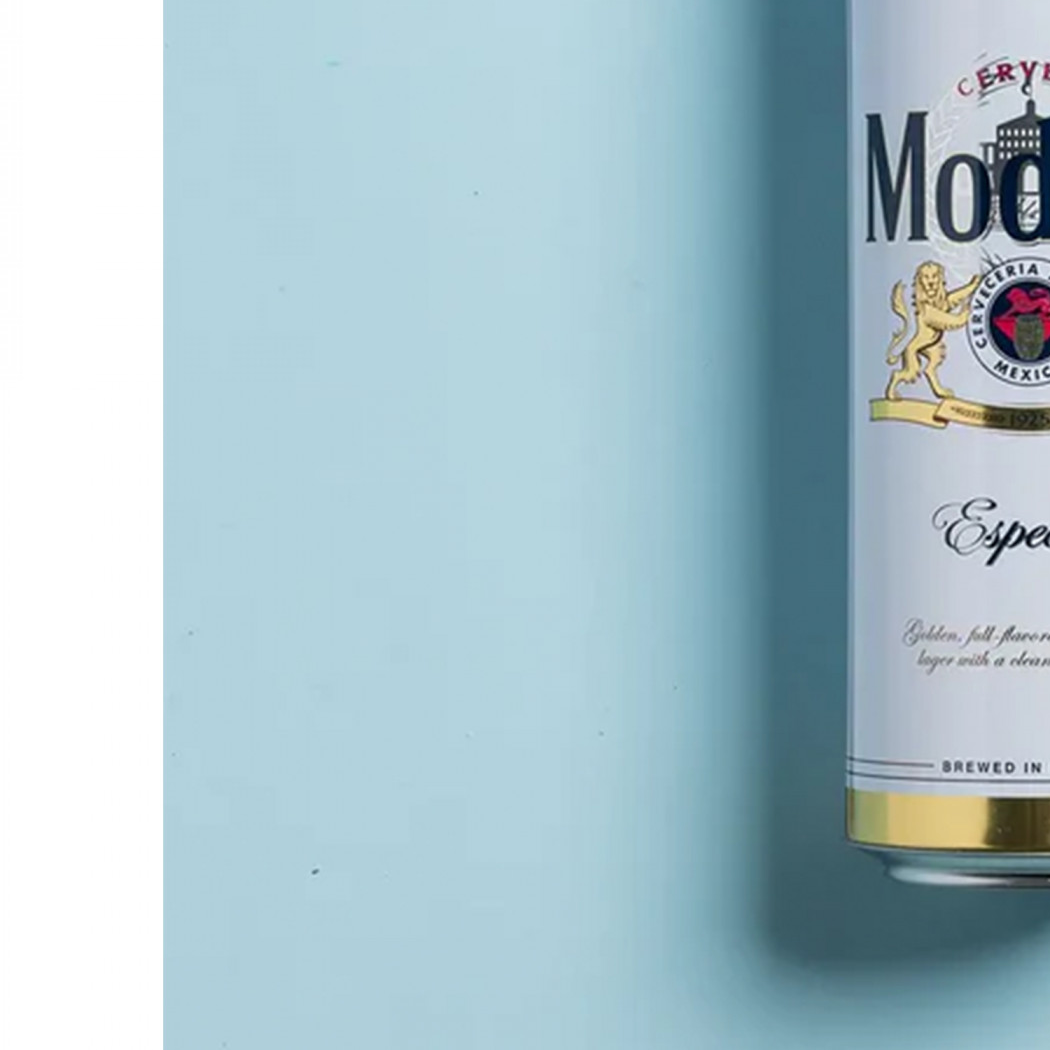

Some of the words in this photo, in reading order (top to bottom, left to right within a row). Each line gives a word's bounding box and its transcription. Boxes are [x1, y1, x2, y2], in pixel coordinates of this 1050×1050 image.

[971, 263, 1039, 350] CERVECERIA
[917, 649, 953, 675] lager
[956, 651, 990, 667] with
[993, 656, 1005, 667] a
[942, 760, 1016, 774] BREWED
[1023, 761, 1043, 774] IN
